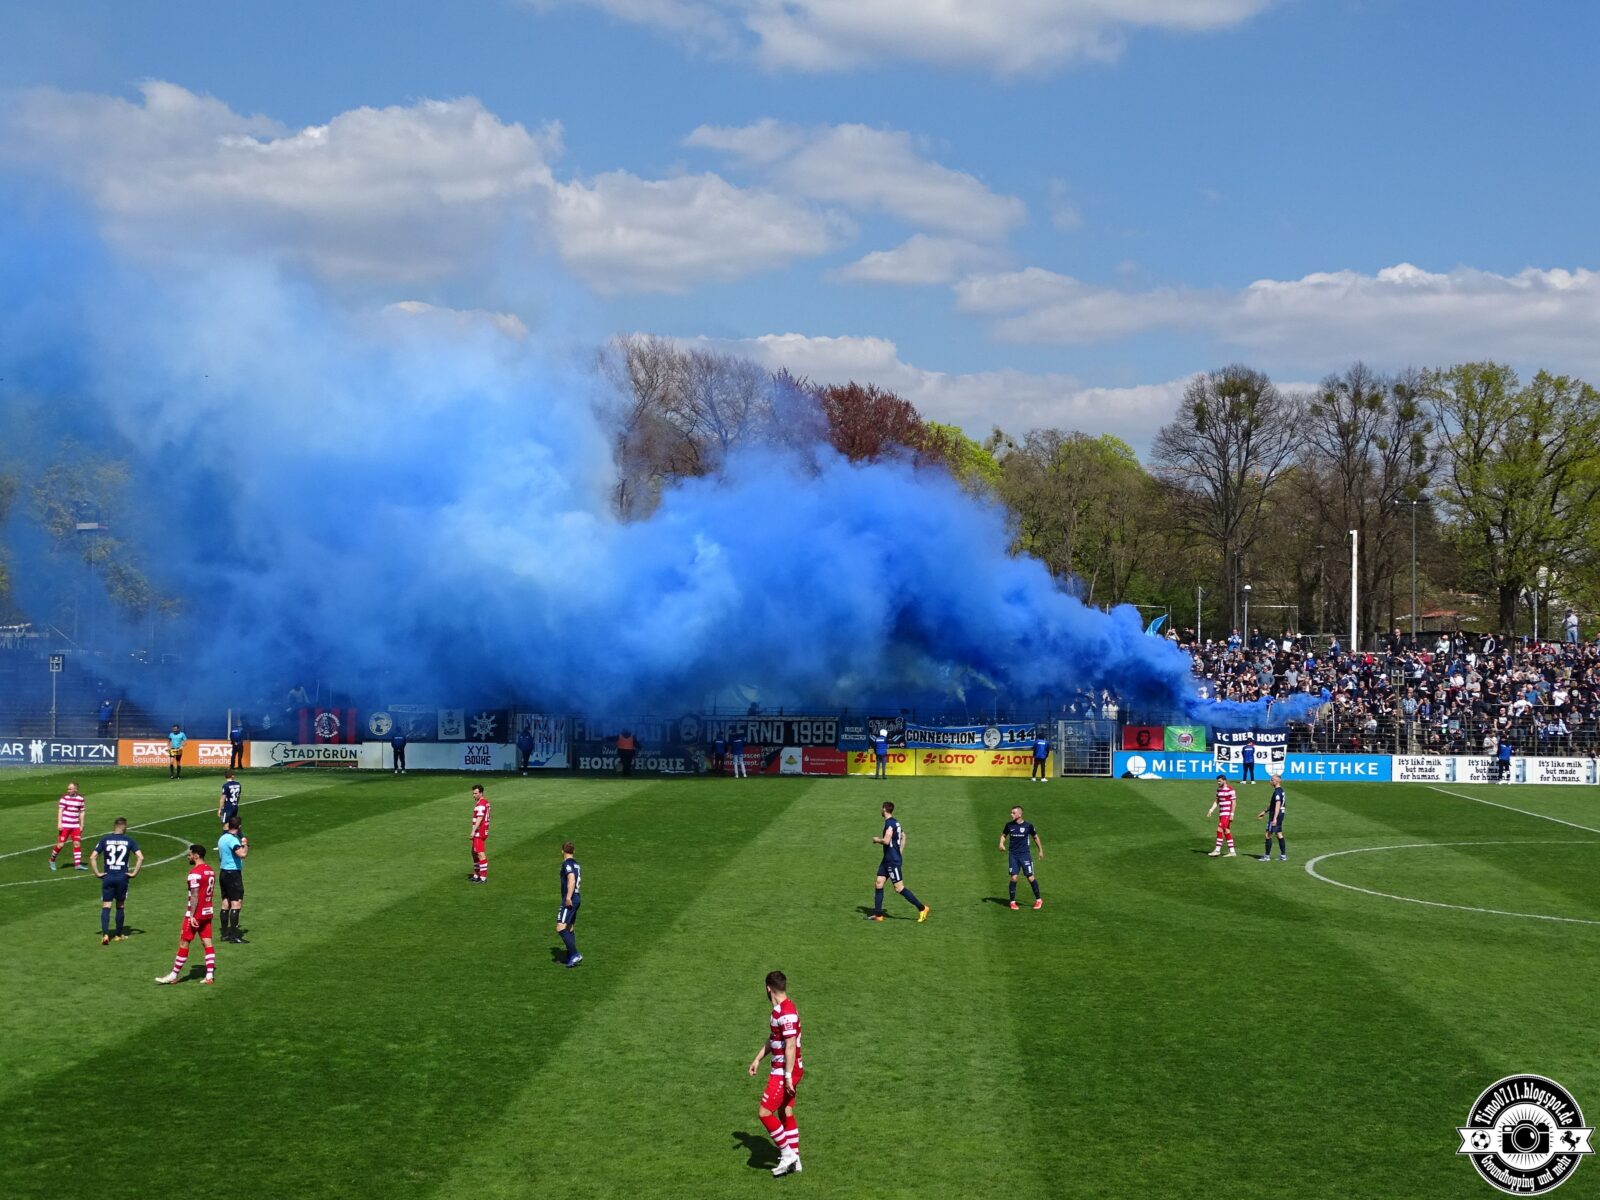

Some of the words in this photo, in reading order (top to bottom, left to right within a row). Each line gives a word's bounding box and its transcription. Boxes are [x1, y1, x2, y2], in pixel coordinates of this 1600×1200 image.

[791, 721, 837, 743] 1999
[905, 729, 976, 744] CONNECTION
[1216, 732, 1230, 742] FC
[1231, 732, 1254, 742] BIER
[50, 744, 115, 757] FRITZ'N
[133, 743, 170, 756] DAK
[198, 744, 233, 757] DAK
[283, 748, 357, 759] STADTGRÜN
[198, 757, 232, 765] Gesundhe
[869, 754, 907, 764] LTTO
[938, 754, 976, 764] LOTTO
[1006, 755, 1034, 765] LOTT
[1256, 752, 1268, 760] 03
[1411, 758, 1425, 766] like
[580, 757, 686, 770] HOMOHOBIE
[1152, 759, 1239, 773] MIETHKE
[1291, 761, 1379, 775] MIETHKE
[1566, 760, 1583, 768] milk
[106, 844, 127, 866] 32
